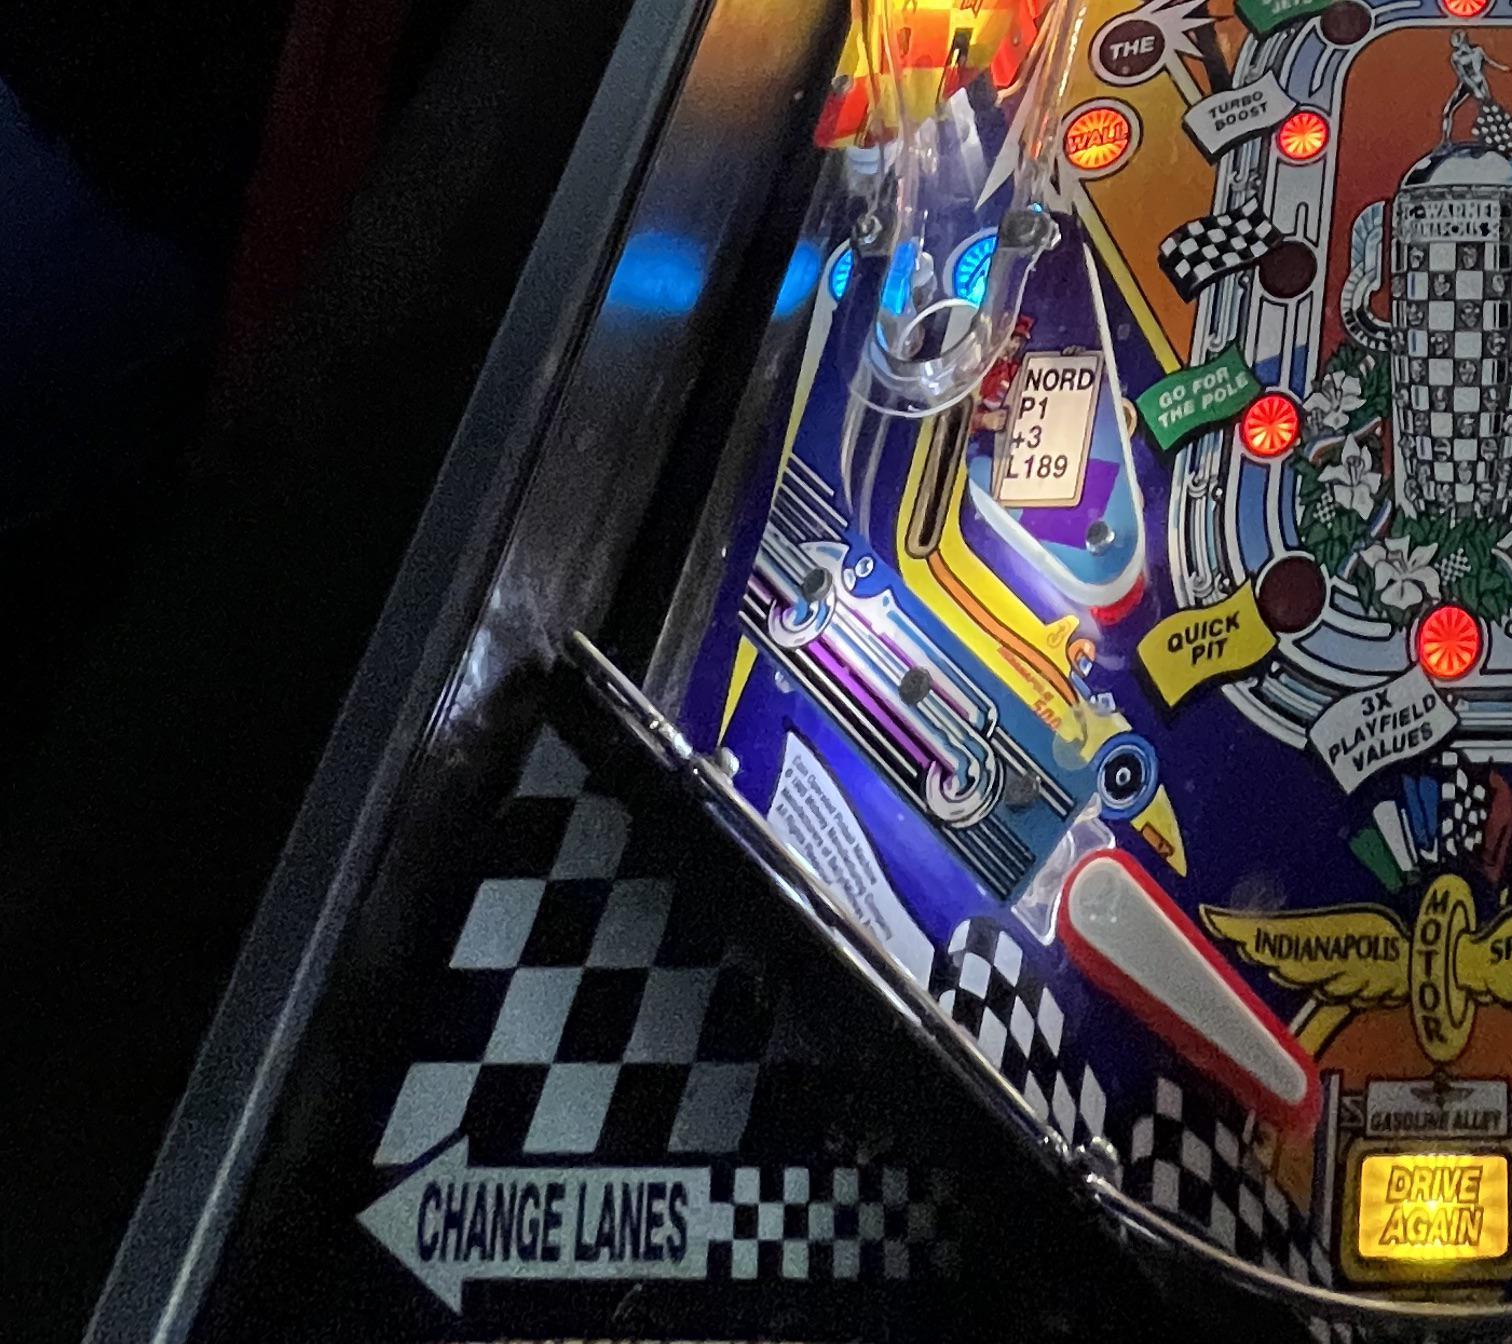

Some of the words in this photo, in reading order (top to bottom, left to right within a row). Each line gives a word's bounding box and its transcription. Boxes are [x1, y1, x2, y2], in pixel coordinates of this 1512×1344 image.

[1109, 35, 1156, 62] THE
[1207, 89, 1265, 120] TURBO
[1213, 101, 1269, 132] BOOST
[1066, 119, 1130, 154] WALL
[1023, 367, 1096, 393] NORD
[1158, 384, 1186, 410] GO
[1191, 365, 1231, 396] FOR
[1018, 395, 1050, 422] P1
[1157, 396, 1197, 430] THE
[1198, 372, 1250, 414] POLE
[1011, 424, 1043, 450] +3
[1003, 453, 1070, 481] L189
[1166, 611, 1243, 655] QUICK
[1189, 636, 1231, 668] PIT
[1360, 690, 1394, 719] 3X
[1328, 692, 1438, 766] PLAYFIELD
[1351, 722, 1436, 773] VALUES
[1253, 926, 1401, 962] INDIANAPOLIS
[1418, 889, 1451, 1045] MOTOR
[1384, 1165, 1484, 1205] DRIVE
[417, 1180, 562, 1263] CHANGE
[573, 1180, 688, 1263] LANES
[1378, 1206, 1485, 1247] AGAIN
